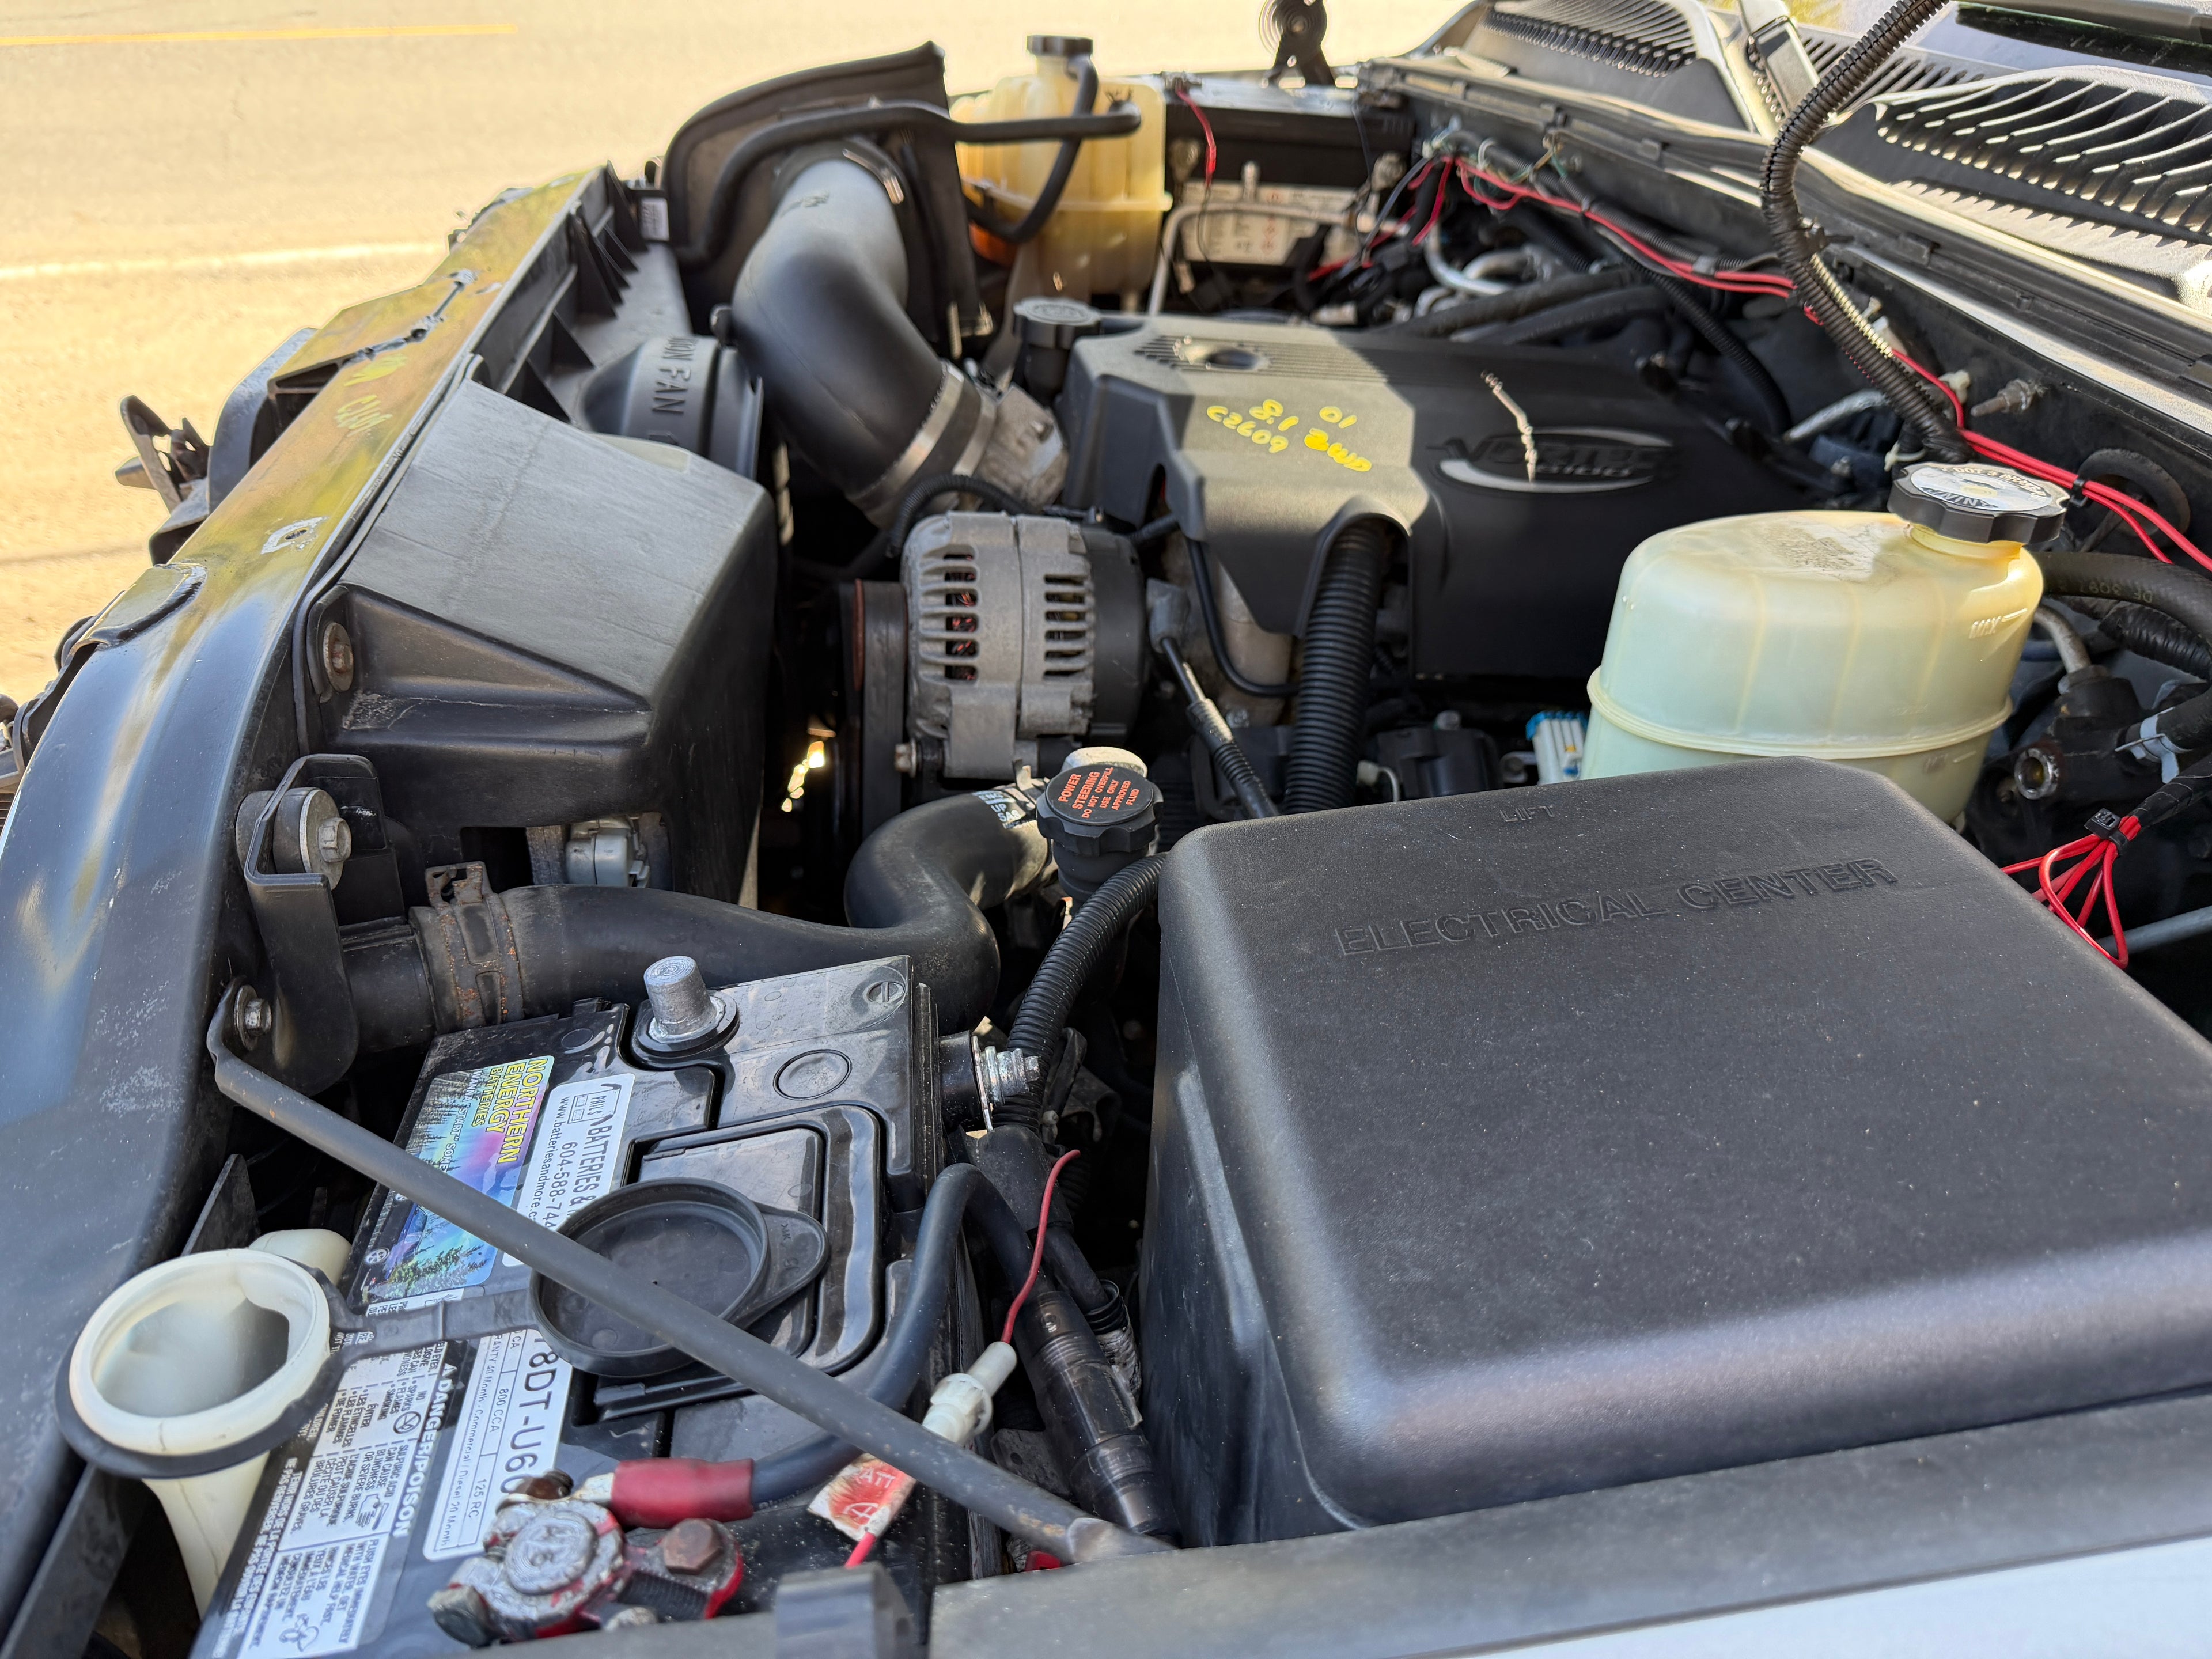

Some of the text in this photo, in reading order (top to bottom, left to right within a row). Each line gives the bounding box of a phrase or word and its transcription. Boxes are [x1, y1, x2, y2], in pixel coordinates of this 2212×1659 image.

[652, 368, 691, 415] FAN
[1058, 773, 1082, 802] POWER
[1072, 771, 1100, 810] STEERING
[1081, 767, 1114, 819] DO NOT OVERFILL
[1100, 779, 1119, 808] USE ONLY
[1111, 781, 1131, 810] APPROVED
[1126, 789, 1140, 805] FLUID
[1499, 805, 1554, 822] LIFT
[1335, 858, 1899, 956] ELECTRICAL CENTER
[462, 1070, 483, 1101] WANNA
[471, 1066, 503, 1126] BATTERIES
[486, 1062, 526, 1133] ENERGY
[497, 1058, 548, 1164] NORTHERN
[587, 1095, 606, 1115] PHIL'S
[528, 1097, 569, 1220] www.batteriesandmore.c
[569, 1125, 612, 1206] BATTERIES &
[540, 1142, 577, 1228] 604-588-744
[419, 1346, 433, 1367] LOSIVE
[510, 1336, 522, 1349] CA
[396, 1350, 412, 1376] NDNESS
[407, 1359, 419, 1373] CAN
[427, 1354, 441, 1373] EYES.
[377, 1388, 395, 1420] SMOKING
[389, 1387, 406, 1414] FLAMES
[400, 1384, 417, 1411] SPARKS
[415, 1390, 426, 1400] NO
[478, 1376, 492, 1402] Month
[326, 1397, 346, 1433] DE FUMER
[332, 1395, 357, 1444] LES FLAMMES
[341, 1393, 369, 1448] LES ÉTINCELLES
[360, 1403, 378, 1428] ÉVITER
[489, 1388, 509, 1433] 800 CCA
[463, 1409, 483, 1461] Commercial
[285, 1457, 297, 1468] NE
[365, 1449, 386, 1490] BLINDNESS
[376, 1446, 397, 1488] CAN CAUSE
[384, 1444, 408, 1498] SULFURIC ACID
[394, 1379, 452, 1536] DANGER/POISON
[278, 1469, 293, 1484] PAS
[286, 1471, 302, 1494] TENIR
[315, 1484, 328, 1496] OU
[317, 1455, 348, 1519] PEUT CAUSER LA
[342, 1450, 374, 1522] OR SEVERE BURNS.
[277, 1495, 293, 1516] HORS
[309, 1497, 323, 1513] DES
[467, 1478, 487, 1518] 125 RC
[272, 1517, 285, 1529] DE
[290, 1501, 310, 1534] GRAVES.
[441, 1515, 456, 1546] Month
[268, 1529, 281, 1540] LA
